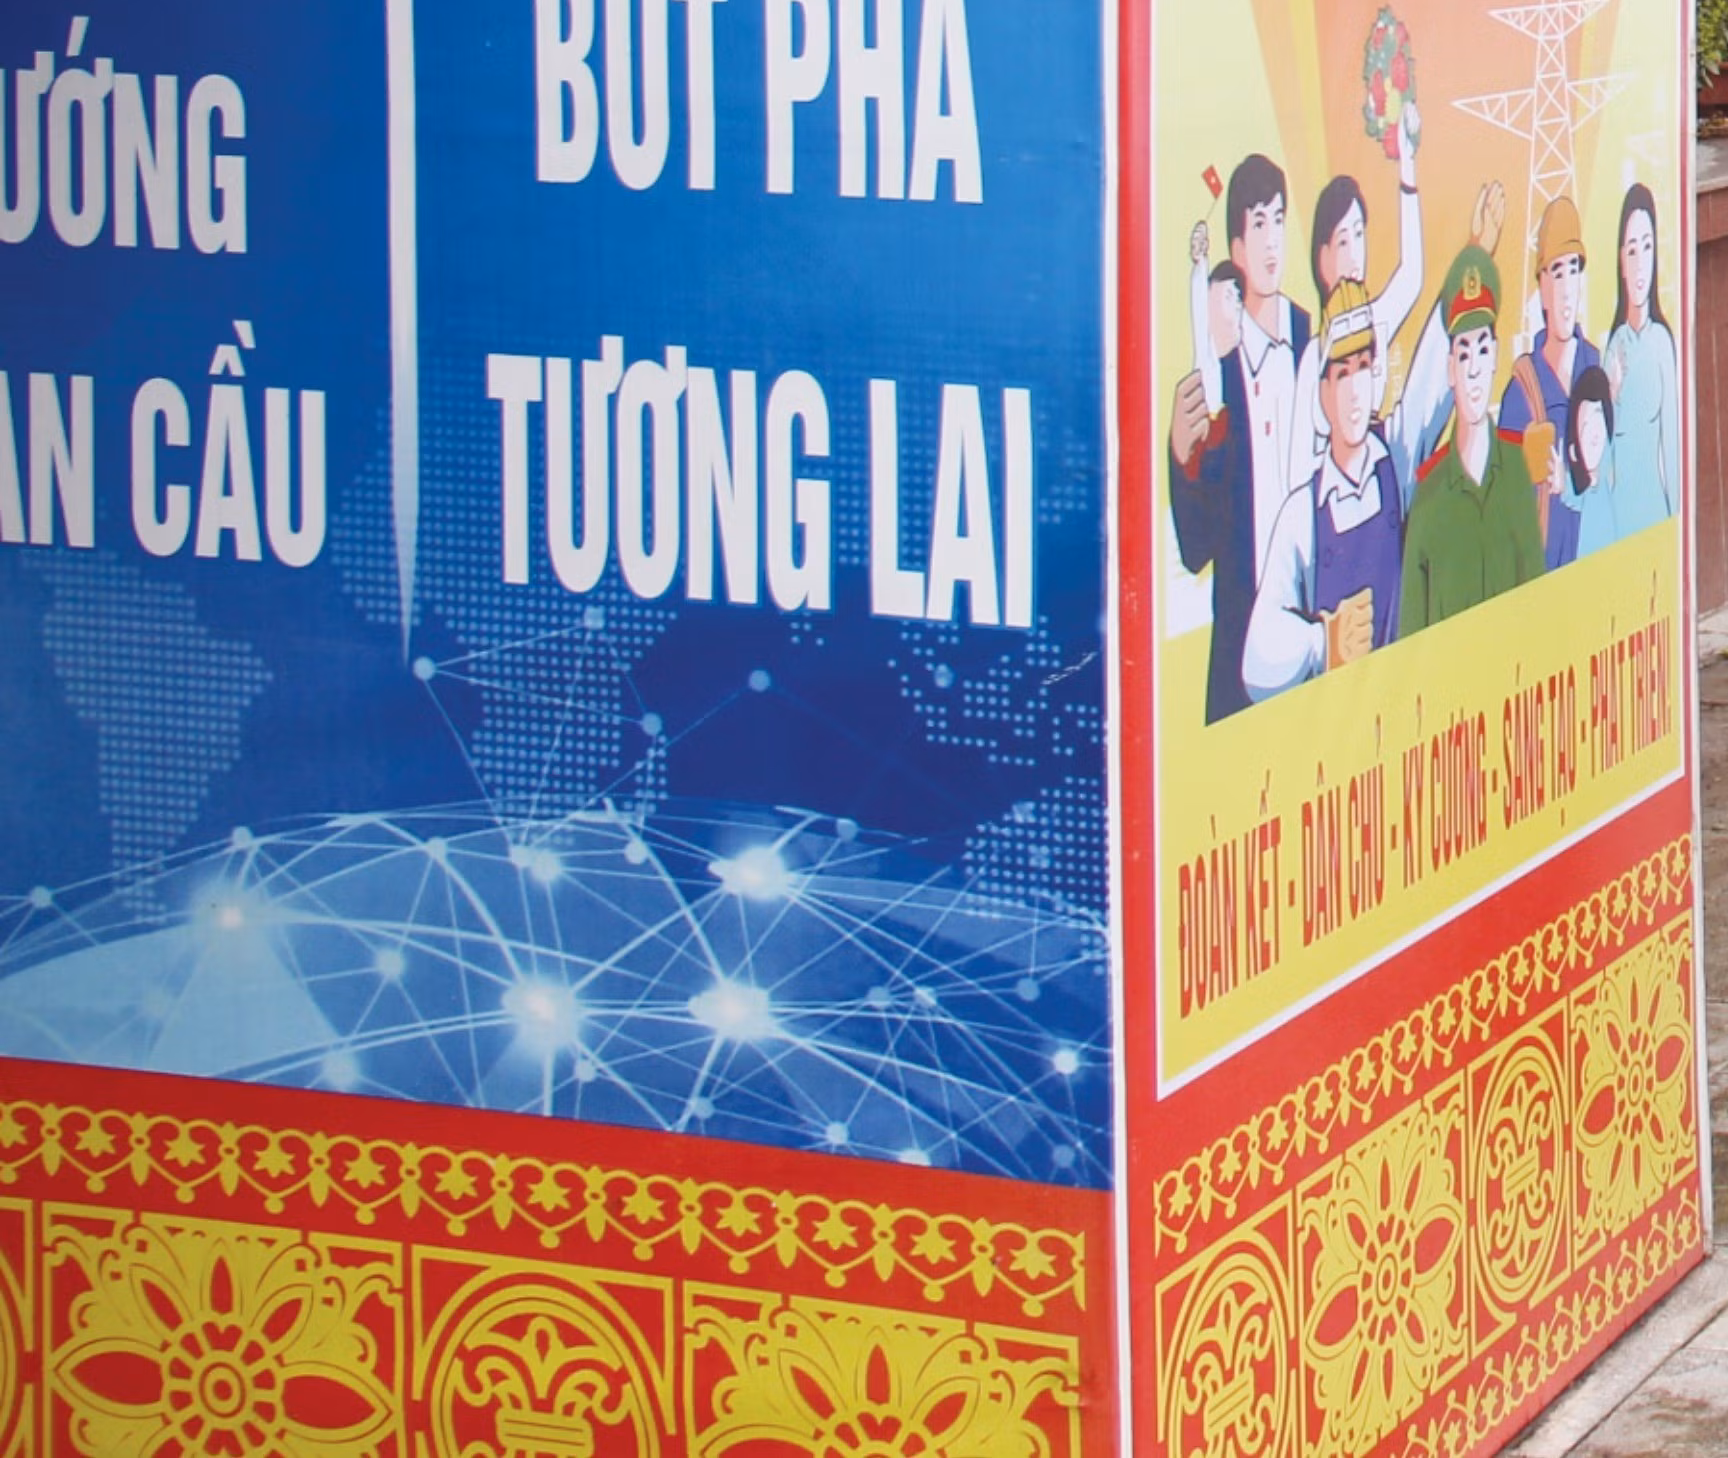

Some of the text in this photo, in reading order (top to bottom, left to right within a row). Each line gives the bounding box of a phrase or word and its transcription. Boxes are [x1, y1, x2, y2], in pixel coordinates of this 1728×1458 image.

[0, 16, 248, 254] ƯỚNG
[131, 320, 327, 568] CẦU
[486, 335, 1034, 629] TƯƠNG LAI
[1178, 814, 1238, 1020] ĐOÀN
[1243, 769, 1281, 983] KẾT
[1301, 761, 1343, 948] DÂN
[1347, 714, 1385, 921] CHỦ
[1402, 693, 1425, 890] KỶ
[1430, 707, 1487, 873] CƯƠNG
[1502, 663, 1545, 830] SÁNG
[1548, 664, 1578, 828] TẠO
[1590, 615, 1625, 779] PHÁT
